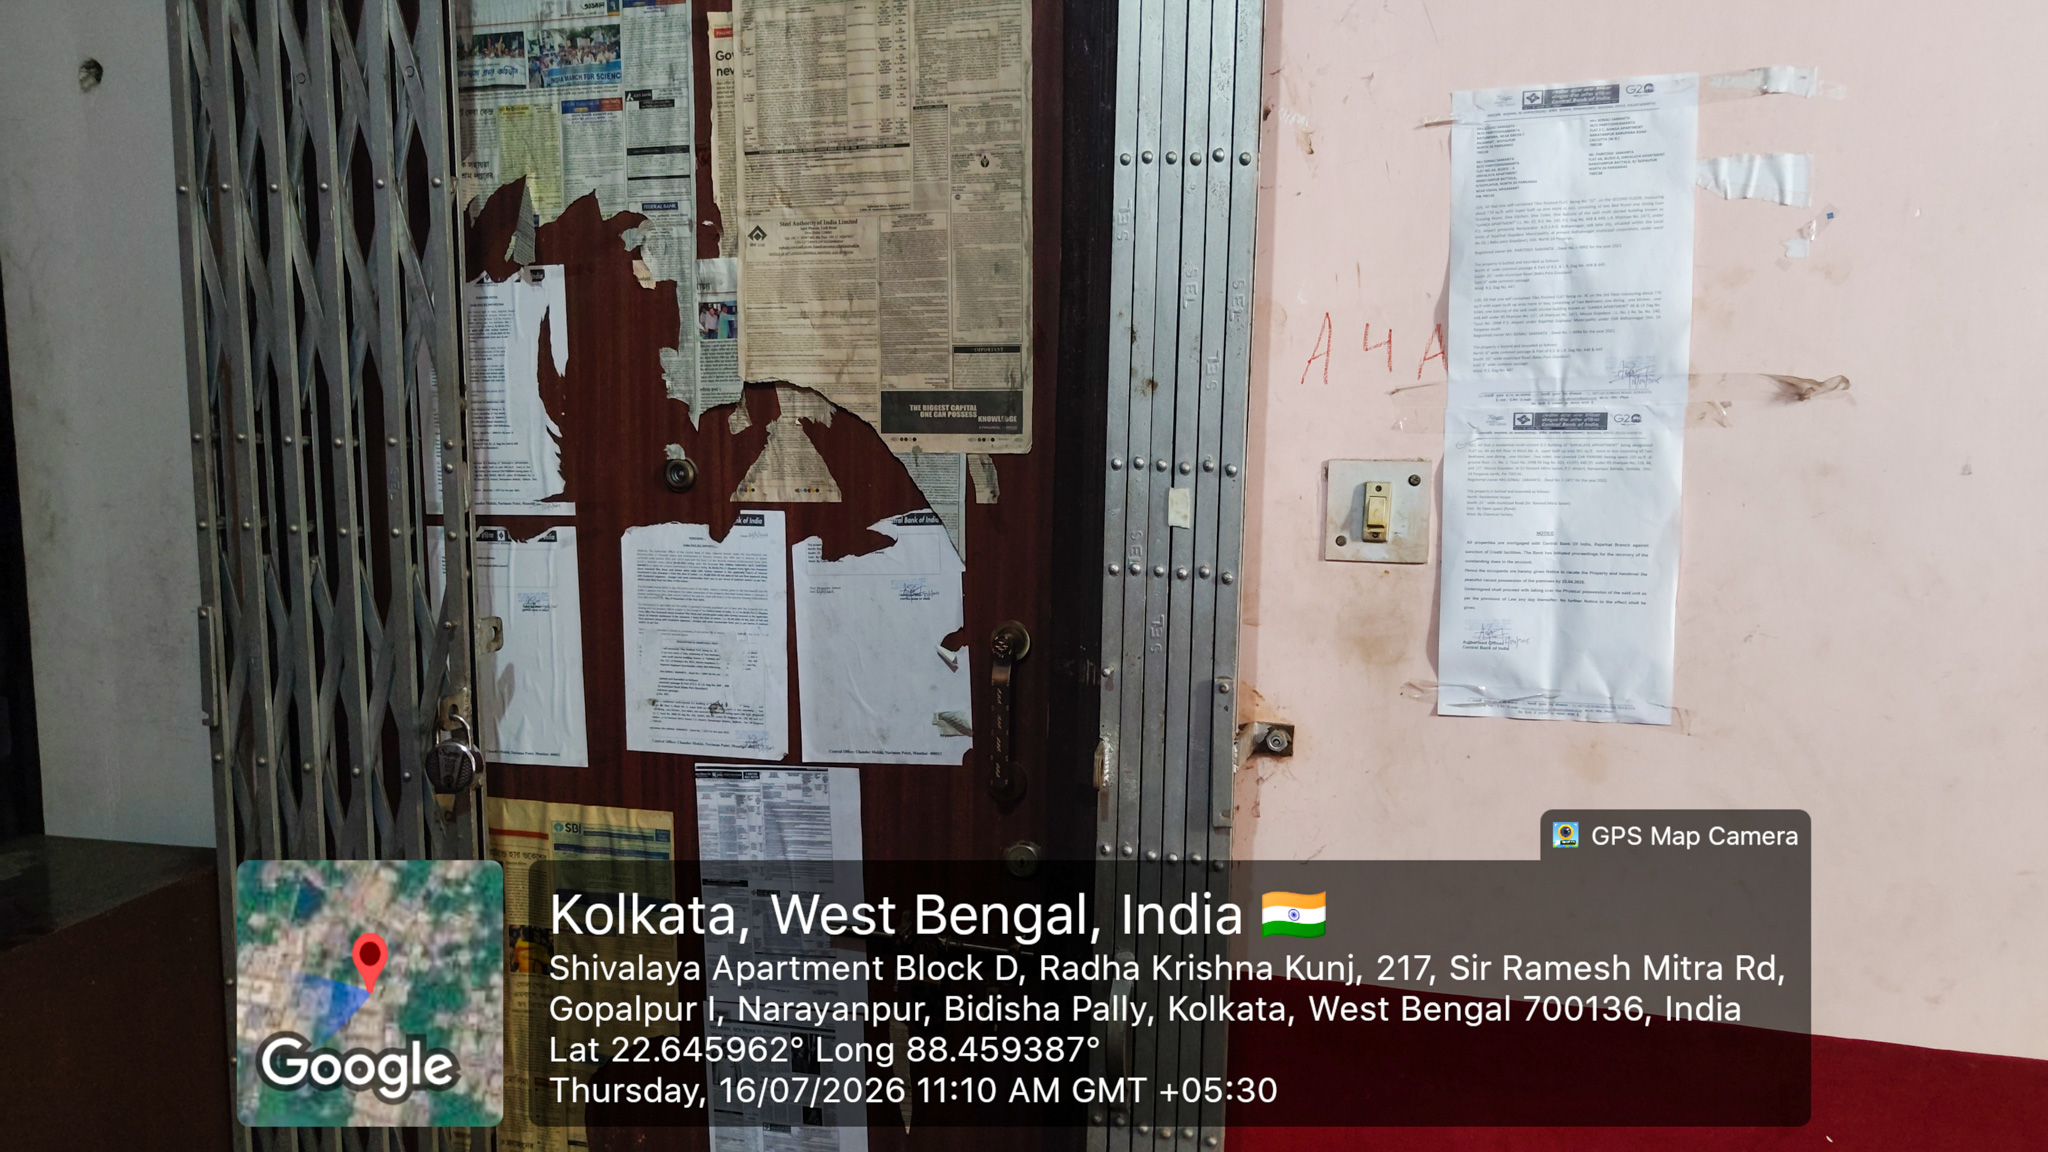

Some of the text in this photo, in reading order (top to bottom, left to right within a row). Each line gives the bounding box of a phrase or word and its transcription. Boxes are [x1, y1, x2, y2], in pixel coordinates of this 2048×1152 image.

[584, 73, 595, 81] FOR
[792, 220, 816, 228] Authority
[1117, 198, 1133, 241] SEL
[1205, 350, 1221, 391] SEL
[749, 516, 763, 524] India
[904, 516, 918, 524] Bank
[926, 515, 939, 523] India
[565, 823, 582, 834] SBI
